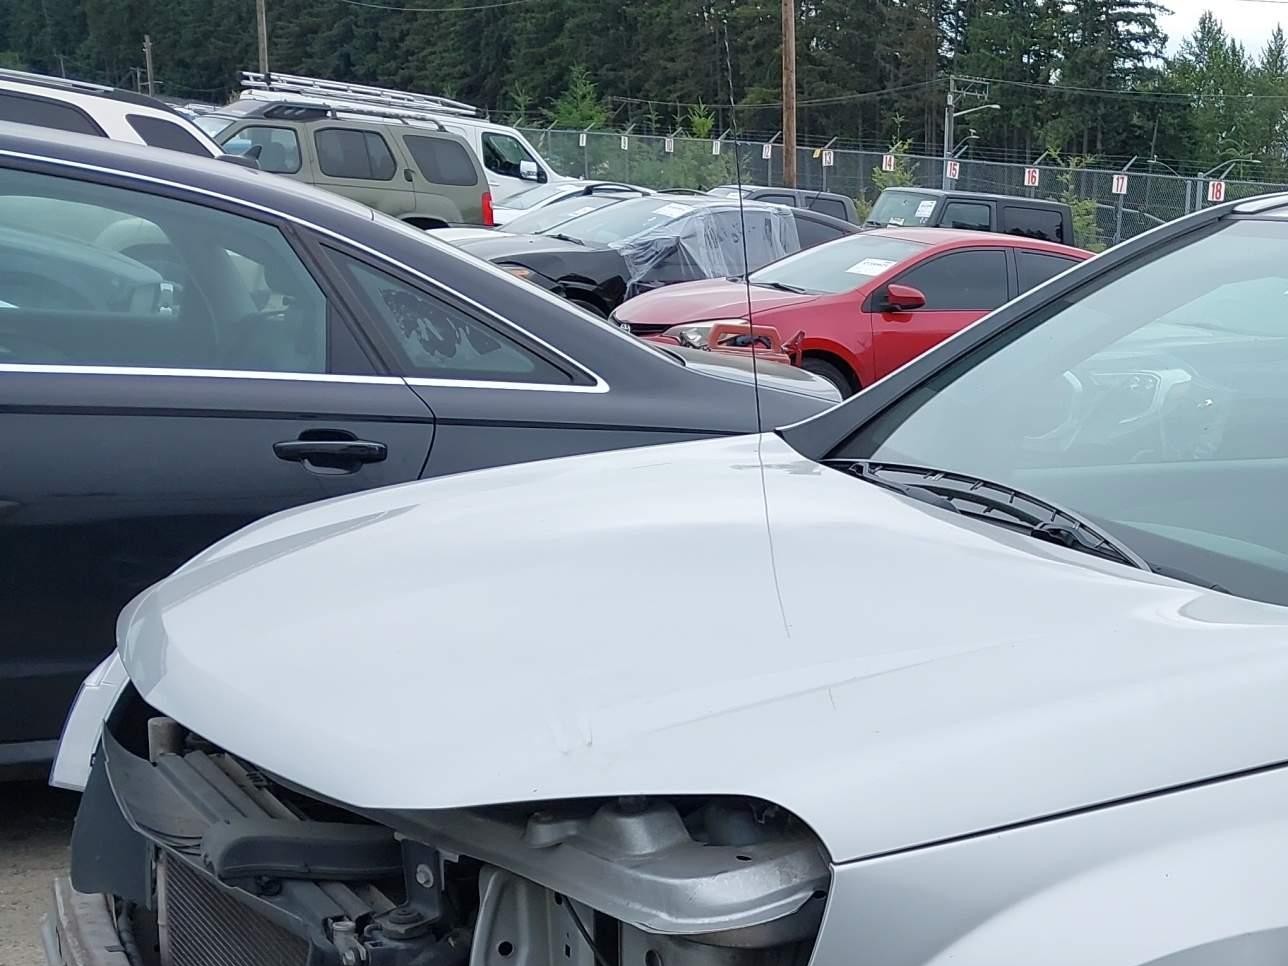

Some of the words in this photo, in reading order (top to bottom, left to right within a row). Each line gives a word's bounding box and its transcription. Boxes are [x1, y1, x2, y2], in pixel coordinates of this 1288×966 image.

[824, 151, 832, 165] 13
[884, 156, 893, 169] 14
[949, 162, 957, 177] 15
[1027, 170, 1036, 185] 16
[1115, 176, 1124, 192] 17
[1211, 183, 1221, 200] 18
